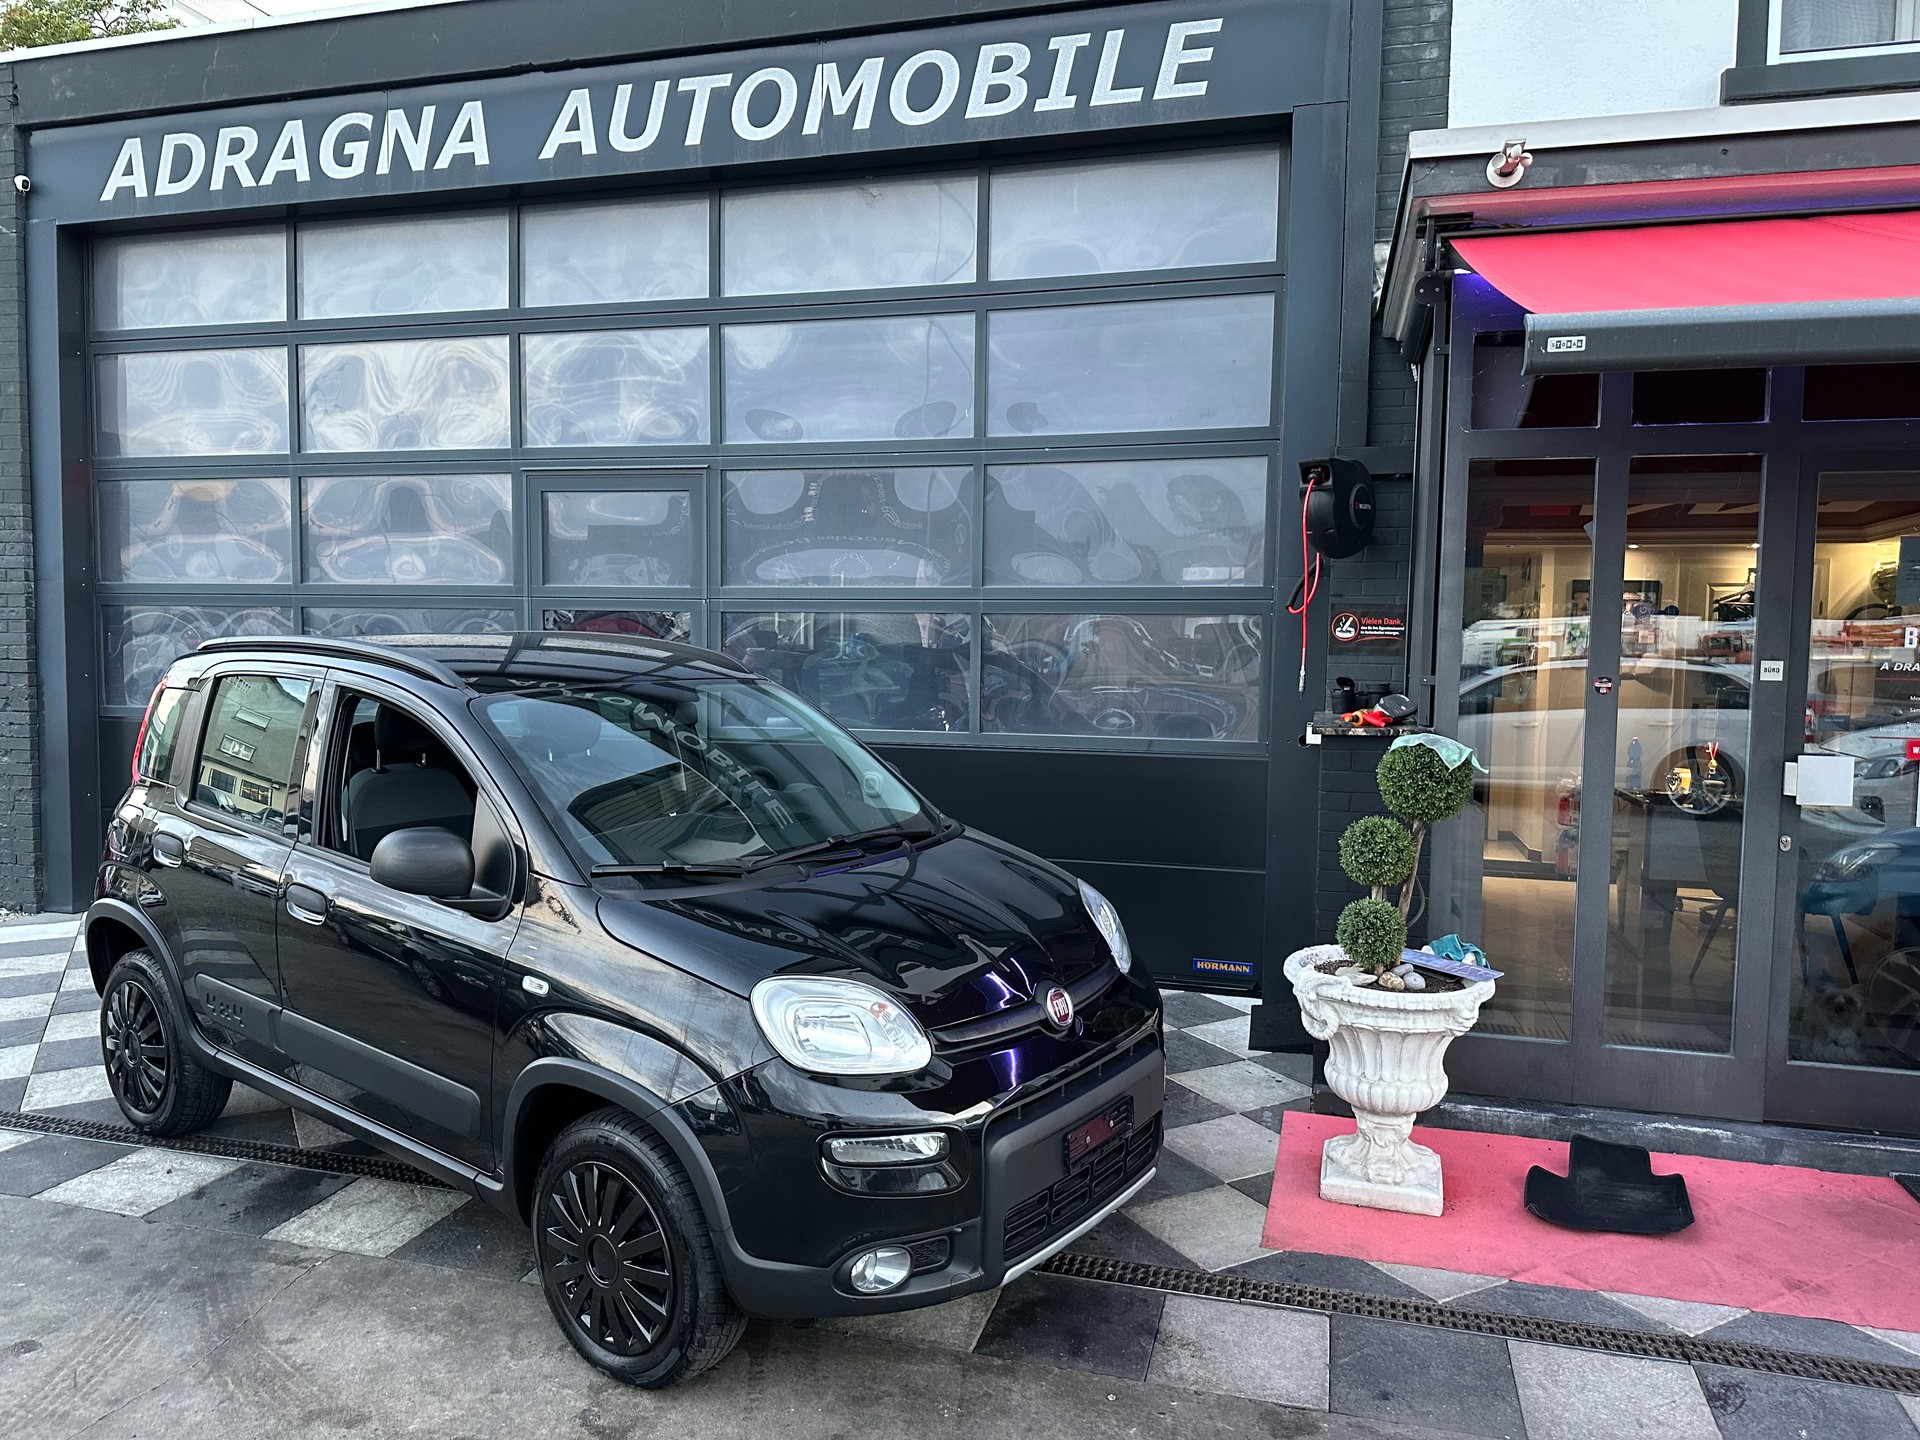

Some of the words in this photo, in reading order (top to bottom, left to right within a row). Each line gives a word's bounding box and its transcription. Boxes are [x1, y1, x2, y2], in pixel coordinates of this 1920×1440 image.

[98, 100, 490, 202] ADRAGNA
[538, 16, 1224, 161] AUTOMOBILE
[1550, 339, 1583, 349] STOBAG
[1360, 616, 1383, 625] Vielen
[1763, 666, 1780, 674] BÜRO
[1052, 997, 1069, 1018] FIAT
